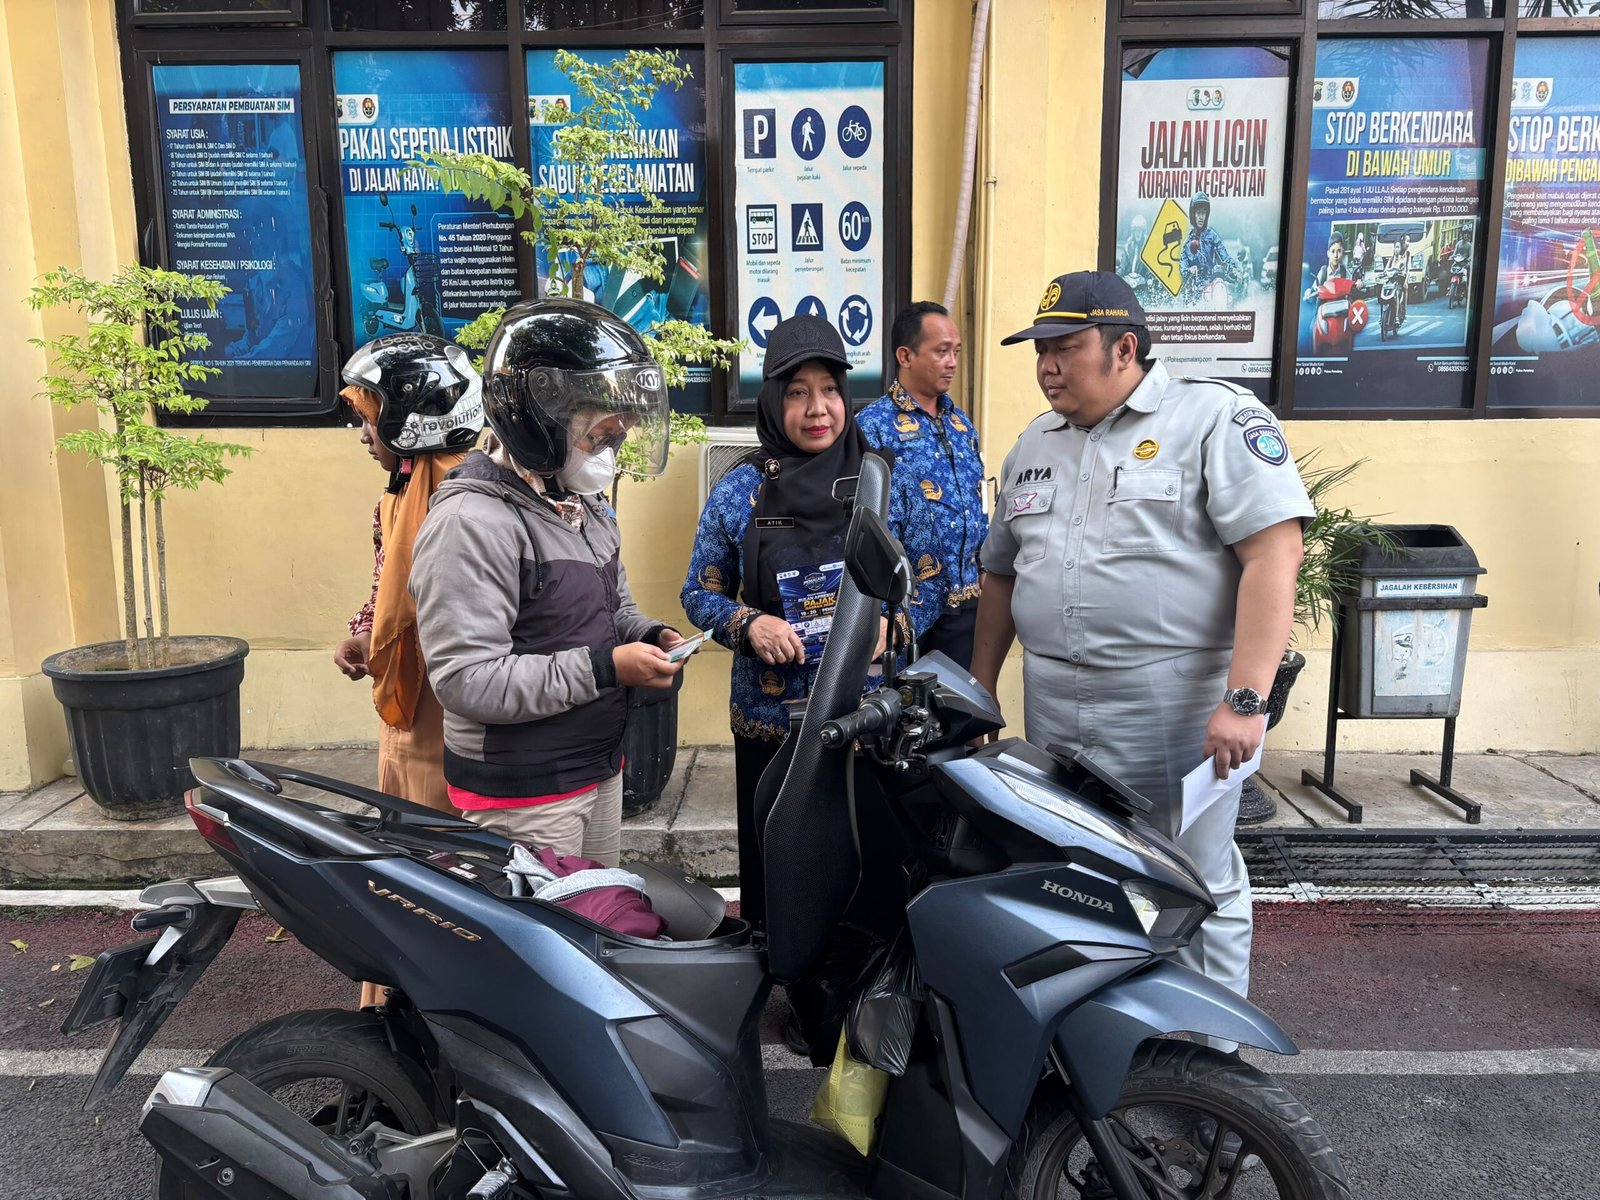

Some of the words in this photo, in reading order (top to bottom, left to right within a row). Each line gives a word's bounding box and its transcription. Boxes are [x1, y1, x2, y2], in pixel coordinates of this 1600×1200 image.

[174, 101, 226, 111] PERSYARATAN
[229, 101, 275, 111] PEMBUATAN
[277, 101, 290, 110] SIM
[1325, 112, 1366, 144] STOP
[1369, 111, 1474, 144] BERKENDARA
[166, 129, 189, 139] SYARAT
[191, 129, 205, 139] USIA
[754, 115, 768, 154] P
[1507, 116, 1553, 152] STOP
[340, 128, 386, 160] PAKAI
[390, 128, 450, 160] SEPEDA
[454, 126, 514, 158] LISTRIK
[610, 129, 678, 159] KENAKAN
[1141, 120, 1208, 169] JALAN
[1212, 119, 1267, 167] LICIN
[1346, 151, 1360, 176] DI
[1362, 150, 1409, 176] BAWAH
[1414, 150, 1451, 176] UMUR
[349, 168, 361, 192] DI
[364, 168, 400, 192] JALAN
[1138, 170, 1192, 198] KURANGI
[1196, 169, 1265, 197] KECEPATAN
[1350, 187, 1361, 195] ayat
[1391, 186, 1407, 194] Setiap
[1408, 186, 1438, 194] pengendara
[1395, 196, 1416, 204] dipidana
[1417, 196, 1436, 204] dengan
[1437, 196, 1454, 204] pidana
[1455, 196, 1479, 204] kurungan
[1507, 192, 1534, 200] Pengemudi
[1504, 200, 1520, 209] Setiap
[172, 209, 195, 219] SYARAT
[197, 209, 239, 219] ADMINISTRASI
[672, 206, 687, 215] yang
[688, 205, 704, 213] benar
[1318, 207, 1334, 215] paling
[1397, 206, 1412, 214] paling
[1413, 206, 1432, 214] banyak
[482, 222, 514, 230] Perhubungan
[842, 211, 861, 241] 60
[752, 233, 773, 245] STOP
[176, 260, 199, 269] SYARAT
[201, 260, 236, 269] KESEHATAN
[240, 260, 273, 269] PSIKOLOGI
[468, 256, 501, 265] menggunakan
[471, 279, 489, 287] sepeda
[1218, 314, 1251, 323] menyebabkan
[1016, 467, 1052, 486] ARYA
[804, 597, 834, 607] PAJAK
[1041, 880, 1115, 914] HONDA
